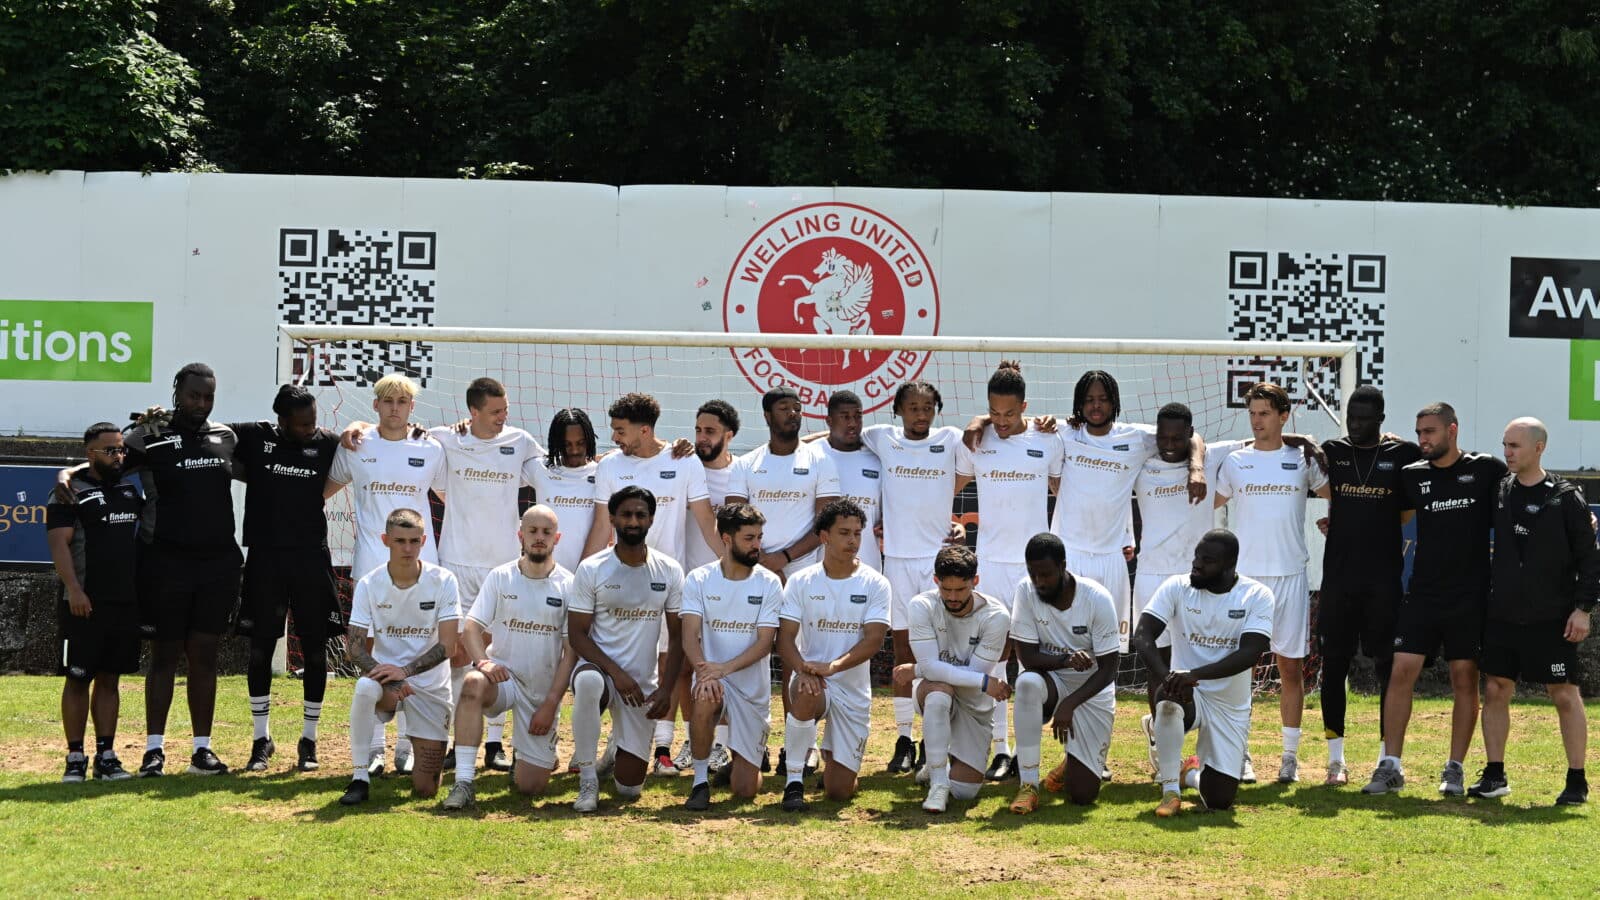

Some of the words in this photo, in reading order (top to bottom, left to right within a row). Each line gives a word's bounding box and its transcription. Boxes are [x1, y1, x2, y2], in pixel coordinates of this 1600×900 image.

[740, 213, 840, 284] WELLING
[850, 216, 923, 288] UNITED
[1528, 276, 1600, 319] Aw
[0, 319, 132, 363] itions
[864, 350, 917, 399] CLUB
[184, 457, 219, 467] finders
[1075, 455, 1121, 470] finders
[273, 463, 311, 475] finders
[464, 468, 509, 479] finders
[895, 465, 939, 476] finders
[990, 470, 1036, 479] finders
[370, 481, 417, 493] finders
[1154, 484, 1186, 496] finde
[1245, 483, 1291, 492] finders
[1341, 483, 1385, 495] finders
[1421, 485, 1430, 494] RA
[757, 489, 800, 499] finders
[553, 495, 594, 505] finders
[1432, 498, 1469, 510] finders
[109, 512, 135, 521] finders
[614, 608, 659, 618] finders
[386, 625, 430, 635] finders
[508, 618, 552, 632] finders
[711, 620, 756, 630] finders
[817, 619, 858, 630] finders
[1189, 632, 1238, 645] finders
[1551, 662, 1566, 672] GDC
